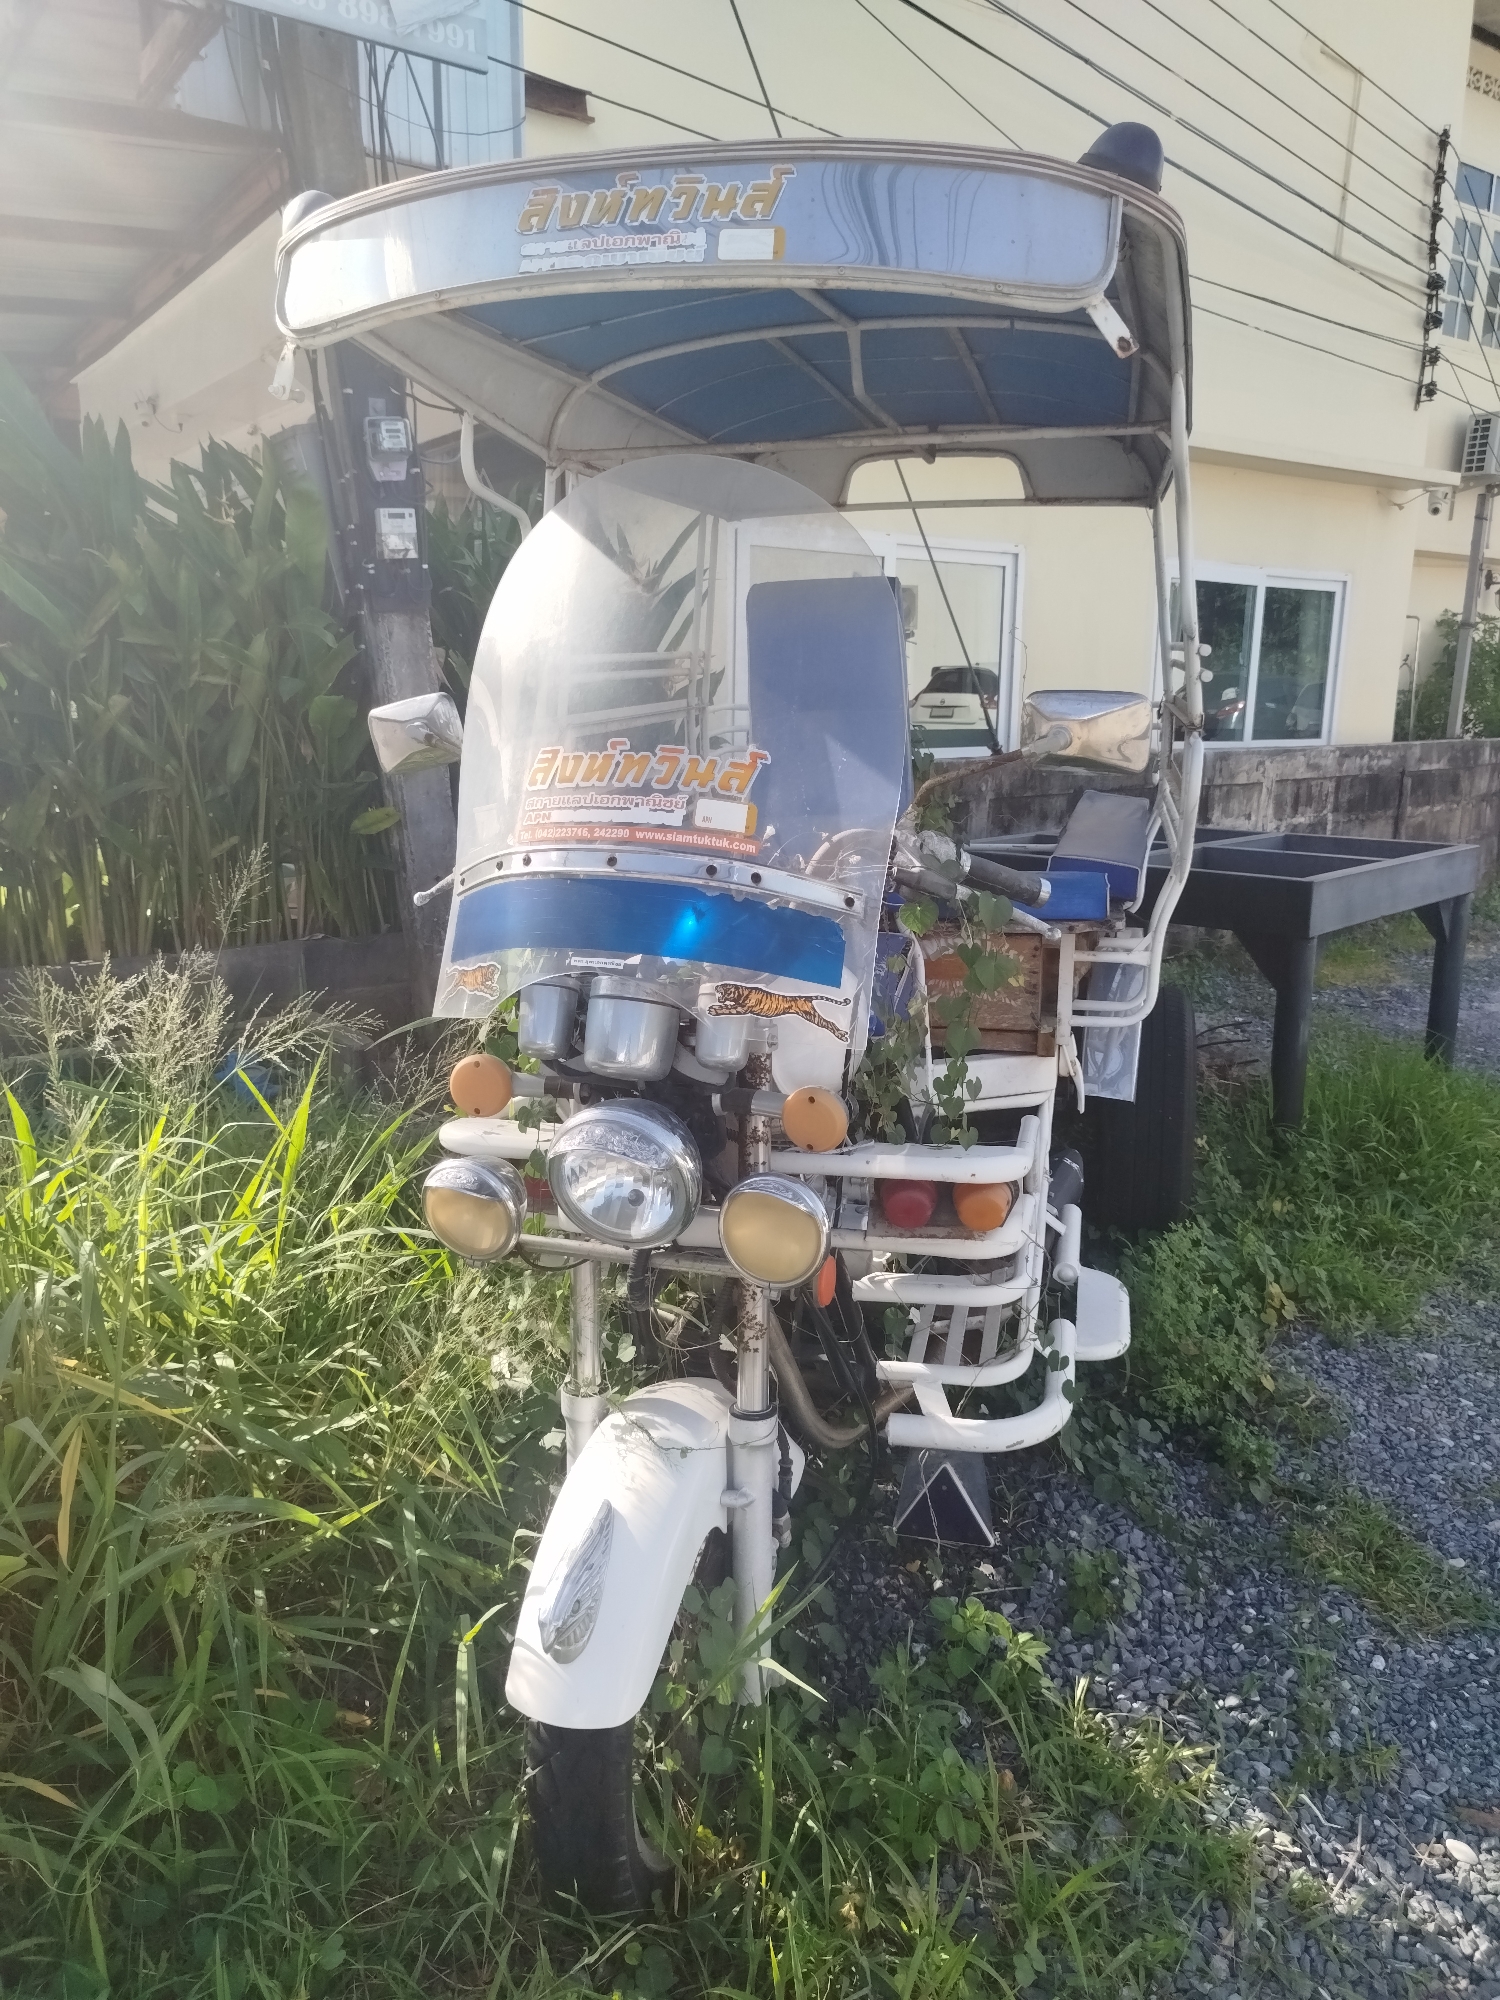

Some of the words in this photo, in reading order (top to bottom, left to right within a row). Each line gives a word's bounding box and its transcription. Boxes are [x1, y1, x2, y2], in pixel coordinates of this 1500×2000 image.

[413, 19, 477, 52] 991
[517, 163, 796, 234] สิงห์ทวินส์
[526, 738, 771, 795] สิงห์ทวินส์
[593, 828, 630, 838] 242290
[635, 829, 757, 854] www.siamtuktuk.com
